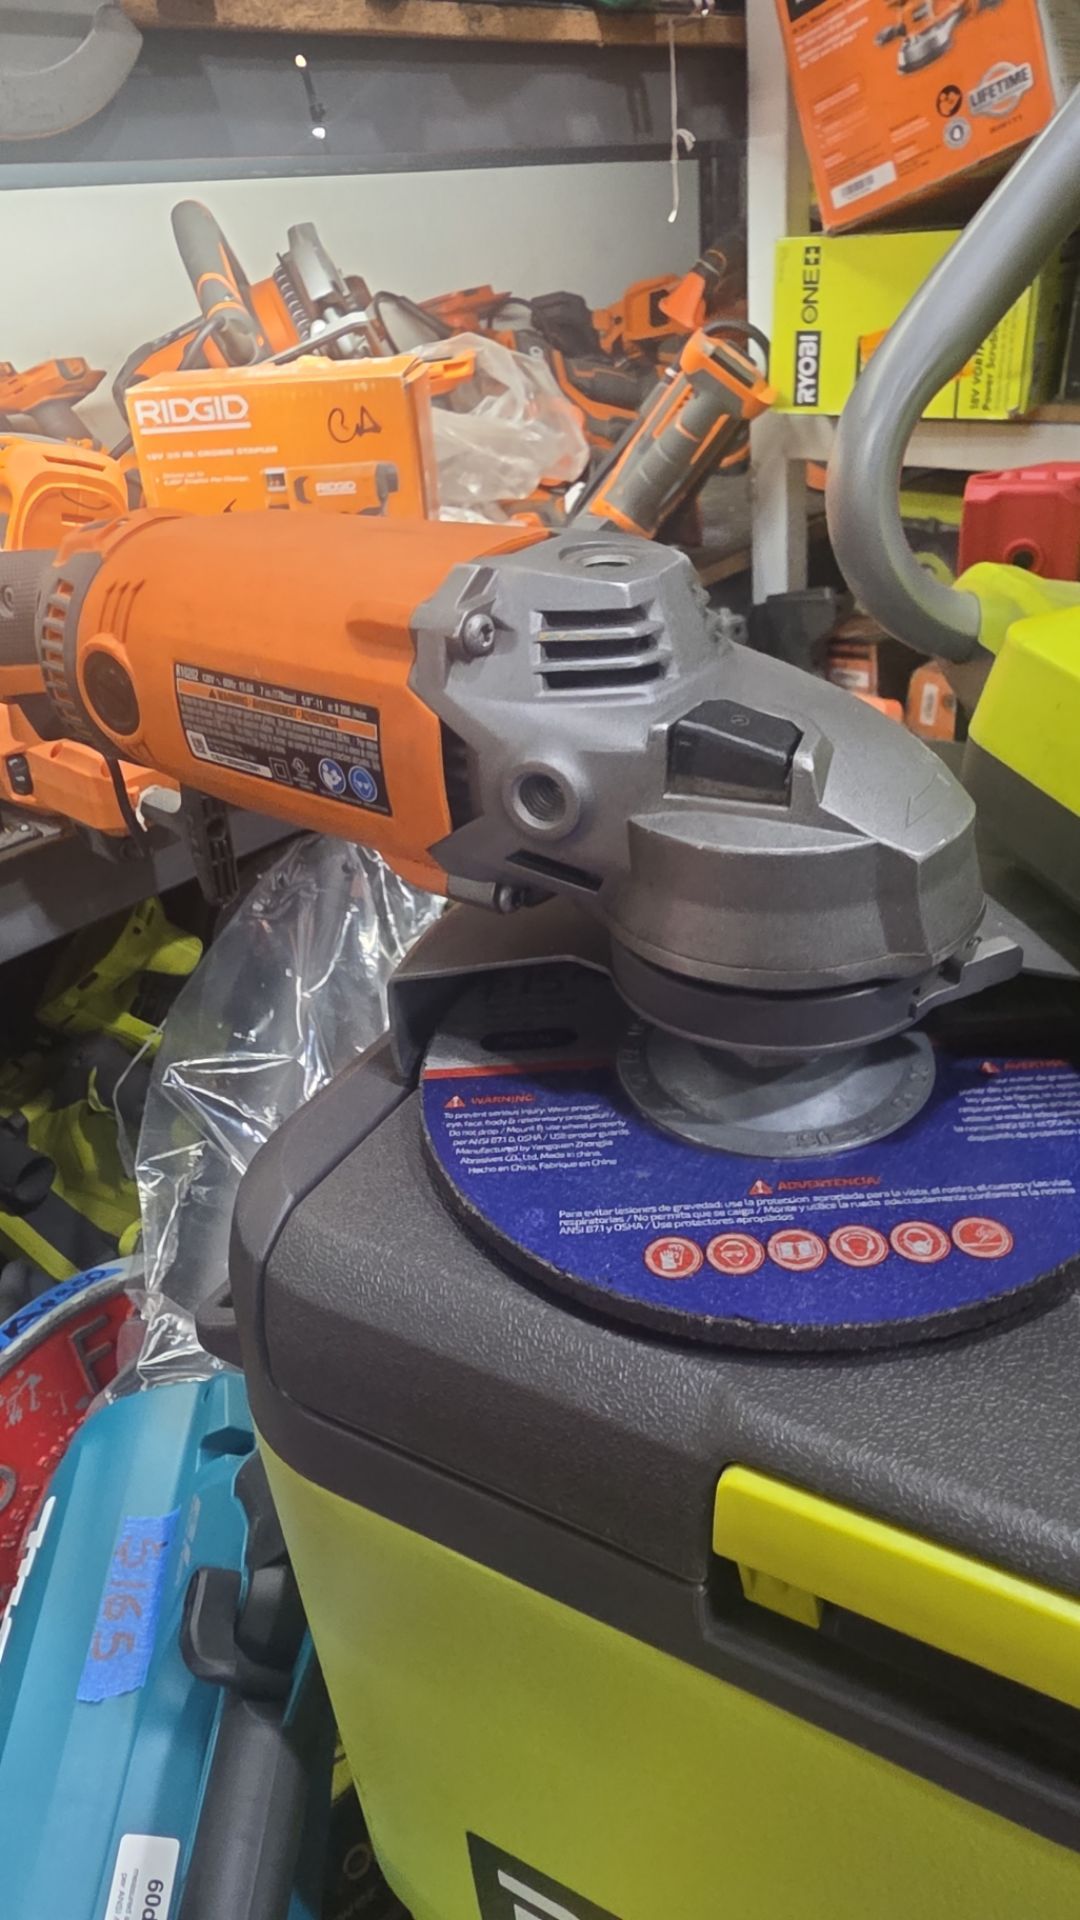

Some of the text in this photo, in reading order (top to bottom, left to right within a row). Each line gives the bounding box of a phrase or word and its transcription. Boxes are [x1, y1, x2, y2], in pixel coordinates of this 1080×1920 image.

[969, 65, 1031, 108] LIFETIME
[797, 335, 818, 404] RYOBI
[133, 394, 249, 425] RIDGID
[315, 481, 356, 494] RIDGID
[471, 1093, 534, 1105] WARNING
[455, 1111, 487, 1120] prevent
[485, 1118, 508, 1126] body
[478, 1128, 500, 1137] drop
[507, 1125, 535, 1134] Mount
[453, 1139, 468, 1147] per
[468, 1137, 490, 1145] ANSI
[517, 1133, 542, 1143] OSHA
[567, 1131, 598, 1140] proper
[456, 1145, 519, 1155] Manufactured
[520, 1144, 531, 1153] by
[460, 1156, 504, 1165] Abrasives
[540, 1152, 566, 1160] Made
[468, 1166, 497, 1175] Hecho
[579, 1160, 591, 1168] en
[559, 1209, 583, 1218] Para
[584, 1208, 613, 1217] evitar
[614, 1205, 658, 1216] lesiones
[658, 1203, 672, 1212] de
[724, 1199, 743, 1208] use
[743, 1198, 755, 1206] la
[866, 1190, 890, 1200] para
[891, 1188, 901, 1197] la
[930, 1186, 940, 1195] el
[559, 1215, 625, 1227] respiratorias
[633, 1213, 649, 1222] No
[650, 1211, 692, 1222] permita
[692, 1210, 712, 1219] que
[713, 1209, 726, 1217] se
[726, 1207, 755, 1218] caiga
[763, 1205, 797, 1214] Monte
[838, 1199, 849, 1209] la
[850, 1199, 881, 1209] rueda
[1040, 1187, 1077, 1196] norma
[559, 1226, 585, 1235] ANSI
[613, 1222, 644, 1232] OSHA
[652, 1220, 673, 1230] Use
[674, 1217, 735, 1229] protectores
[735, 1213, 795, 1225] apropiados
